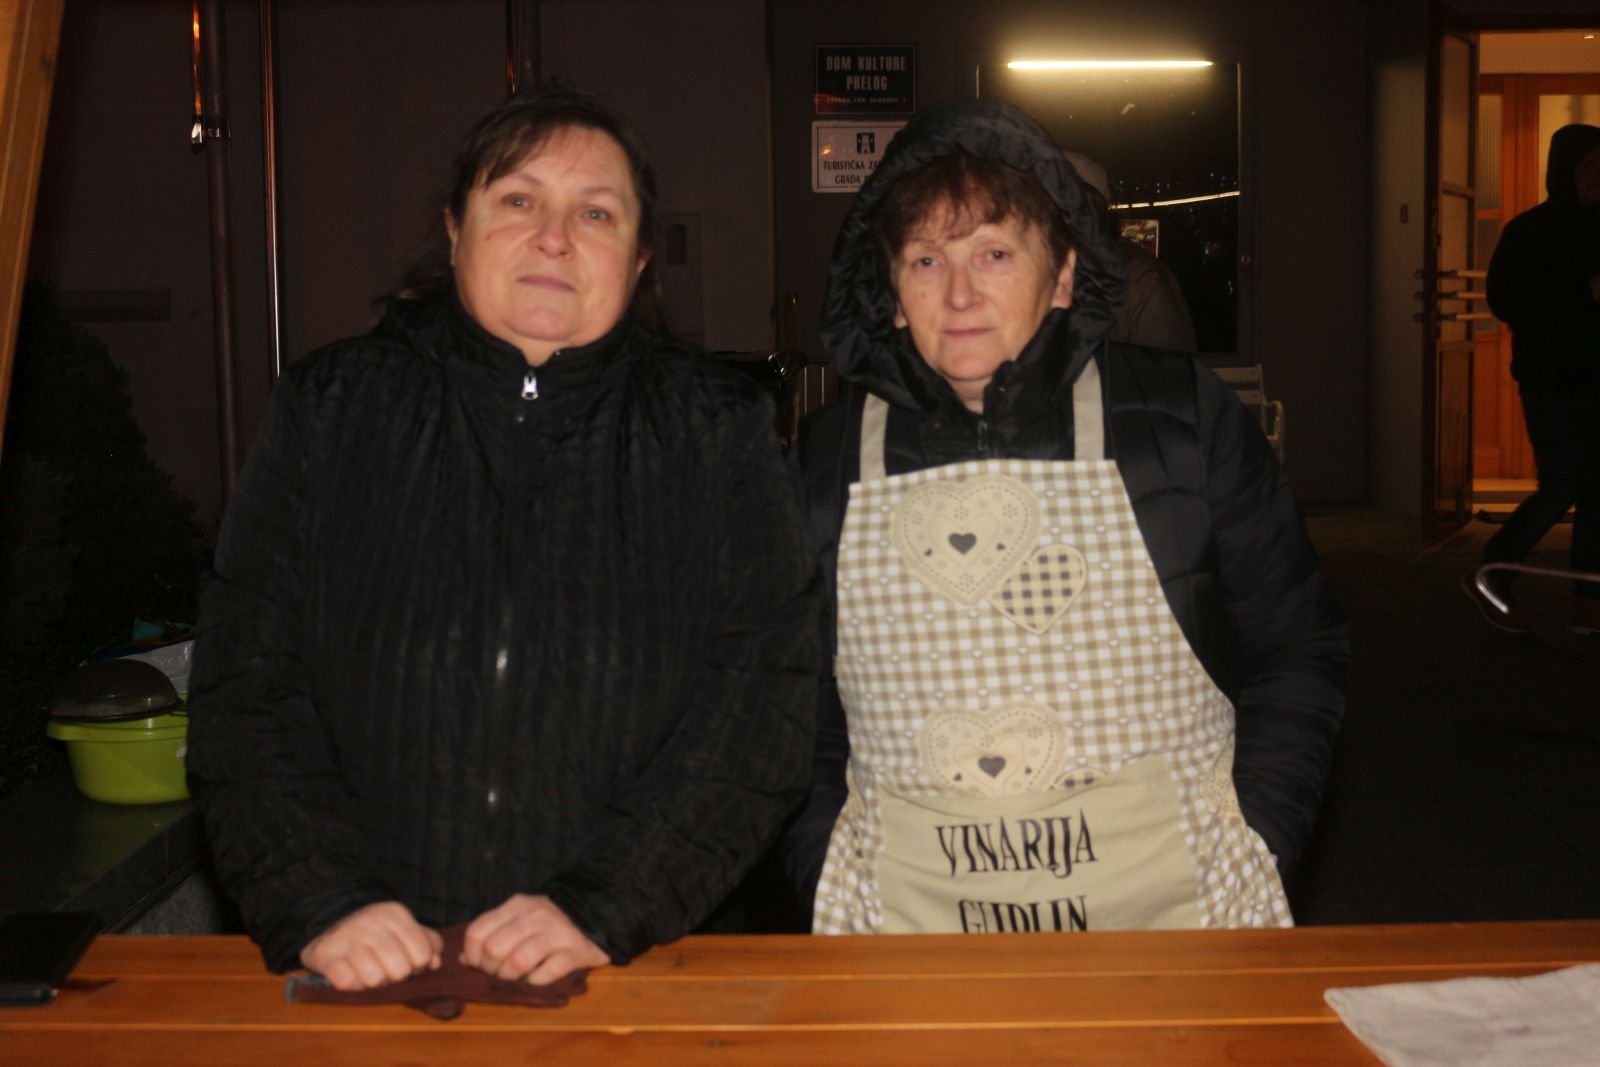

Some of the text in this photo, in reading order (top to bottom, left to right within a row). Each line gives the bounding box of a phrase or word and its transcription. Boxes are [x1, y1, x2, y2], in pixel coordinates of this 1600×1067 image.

[826, 55, 906, 71] DOM KULTURE
[846, 75, 888, 91] PRELOG
[835, 174, 861, 184] GRADA
[935, 808, 1098, 879] VINARIJA
